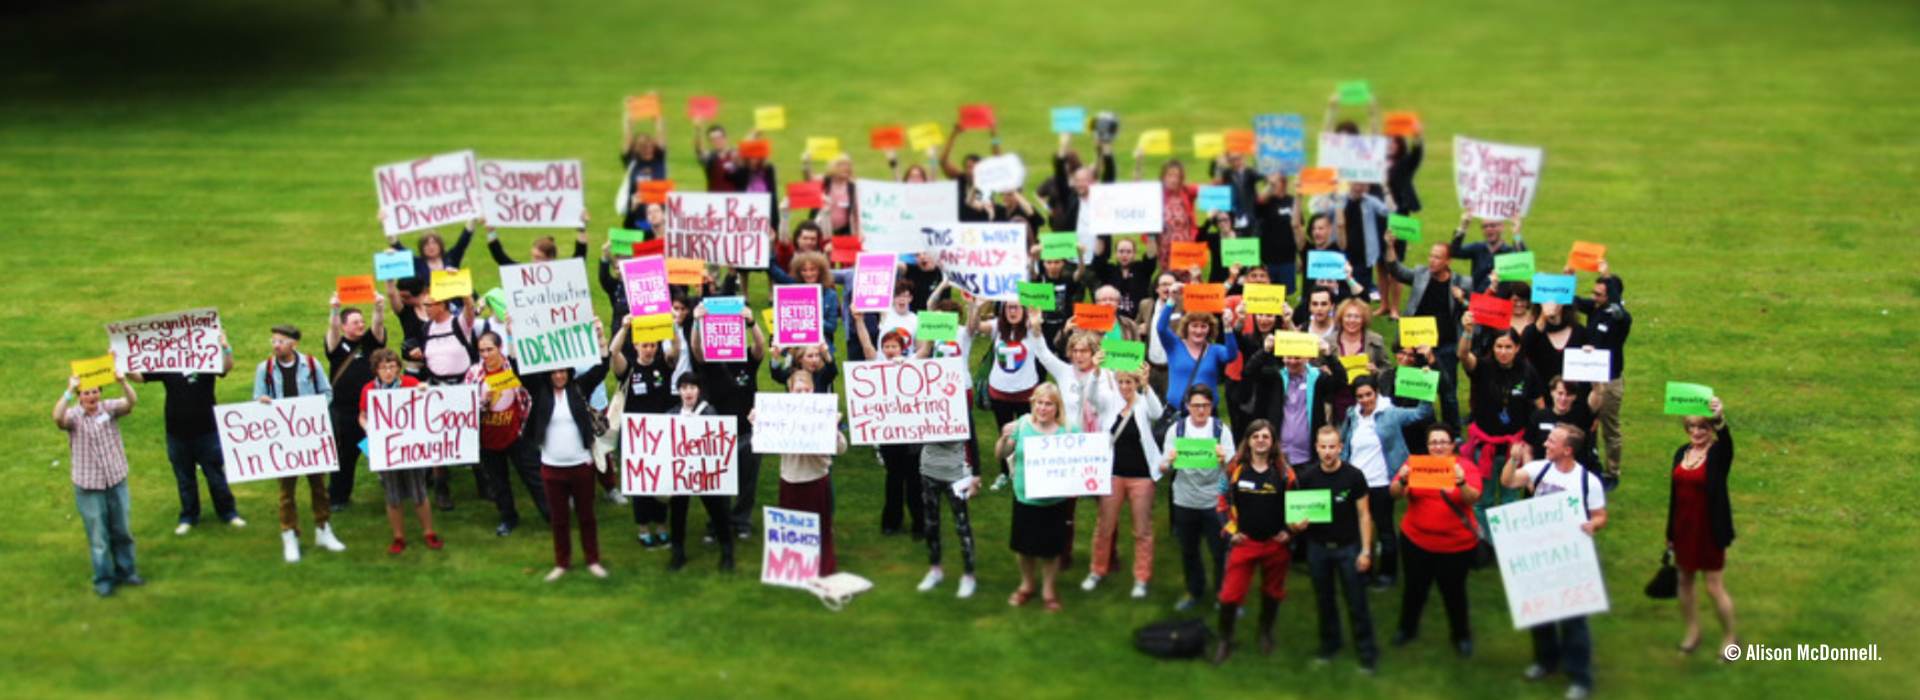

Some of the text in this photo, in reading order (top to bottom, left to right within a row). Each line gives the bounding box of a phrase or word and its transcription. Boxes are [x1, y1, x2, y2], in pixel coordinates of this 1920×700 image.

[379, 155, 476, 205] No Forced
[480, 163, 580, 193] Same Old
[395, 195, 477, 231] Divorce!
[496, 193, 563, 222] Story
[667, 195, 769, 234] Minister Burton
[982, 229, 1020, 242] WHAT
[666, 232, 761, 266] HURRY UP!
[967, 249, 1006, 267] ALLY
[521, 264, 553, 286] NO
[629, 276, 665, 293] BETTER
[632, 290, 668, 306] FUTURE
[1186, 292, 1220, 302] respect
[1535, 285, 1570, 295] equality
[550, 303, 581, 324] MY
[781, 304, 816, 318] BETTER
[705, 322, 741, 335] BETTER
[781, 318, 817, 331] FUTURE
[920, 322, 954, 331] equality
[127, 329, 206, 353] Respect?
[517, 321, 598, 367] IDENTITY
[706, 335, 742, 348] FUTURE
[127, 343, 219, 373] Equality?
[1105, 350, 1140, 361] equality
[852, 361, 943, 398] STOP
[1400, 379, 1433, 390] equality
[372, 390, 479, 434] Not Good
[850, 395, 951, 422] Legislating
[1670, 395, 1710, 406] equality
[223, 404, 327, 444] See You
[854, 417, 968, 443] Transphobia
[385, 427, 461, 468] Enough!
[627, 416, 737, 467] My Identity
[1040, 434, 1087, 450] STOP
[1177, 448, 1213, 458] equality
[233, 435, 339, 477] In Court!
[626, 457, 728, 493] My Right
[1411, 466, 1450, 475] respect
[767, 509, 815, 528] TRANS
[1290, 502, 1327, 512] equality
[1501, 499, 1564, 534] Ireland
[765, 546, 820, 582] NOW
[1509, 541, 1581, 575] HUMAN
